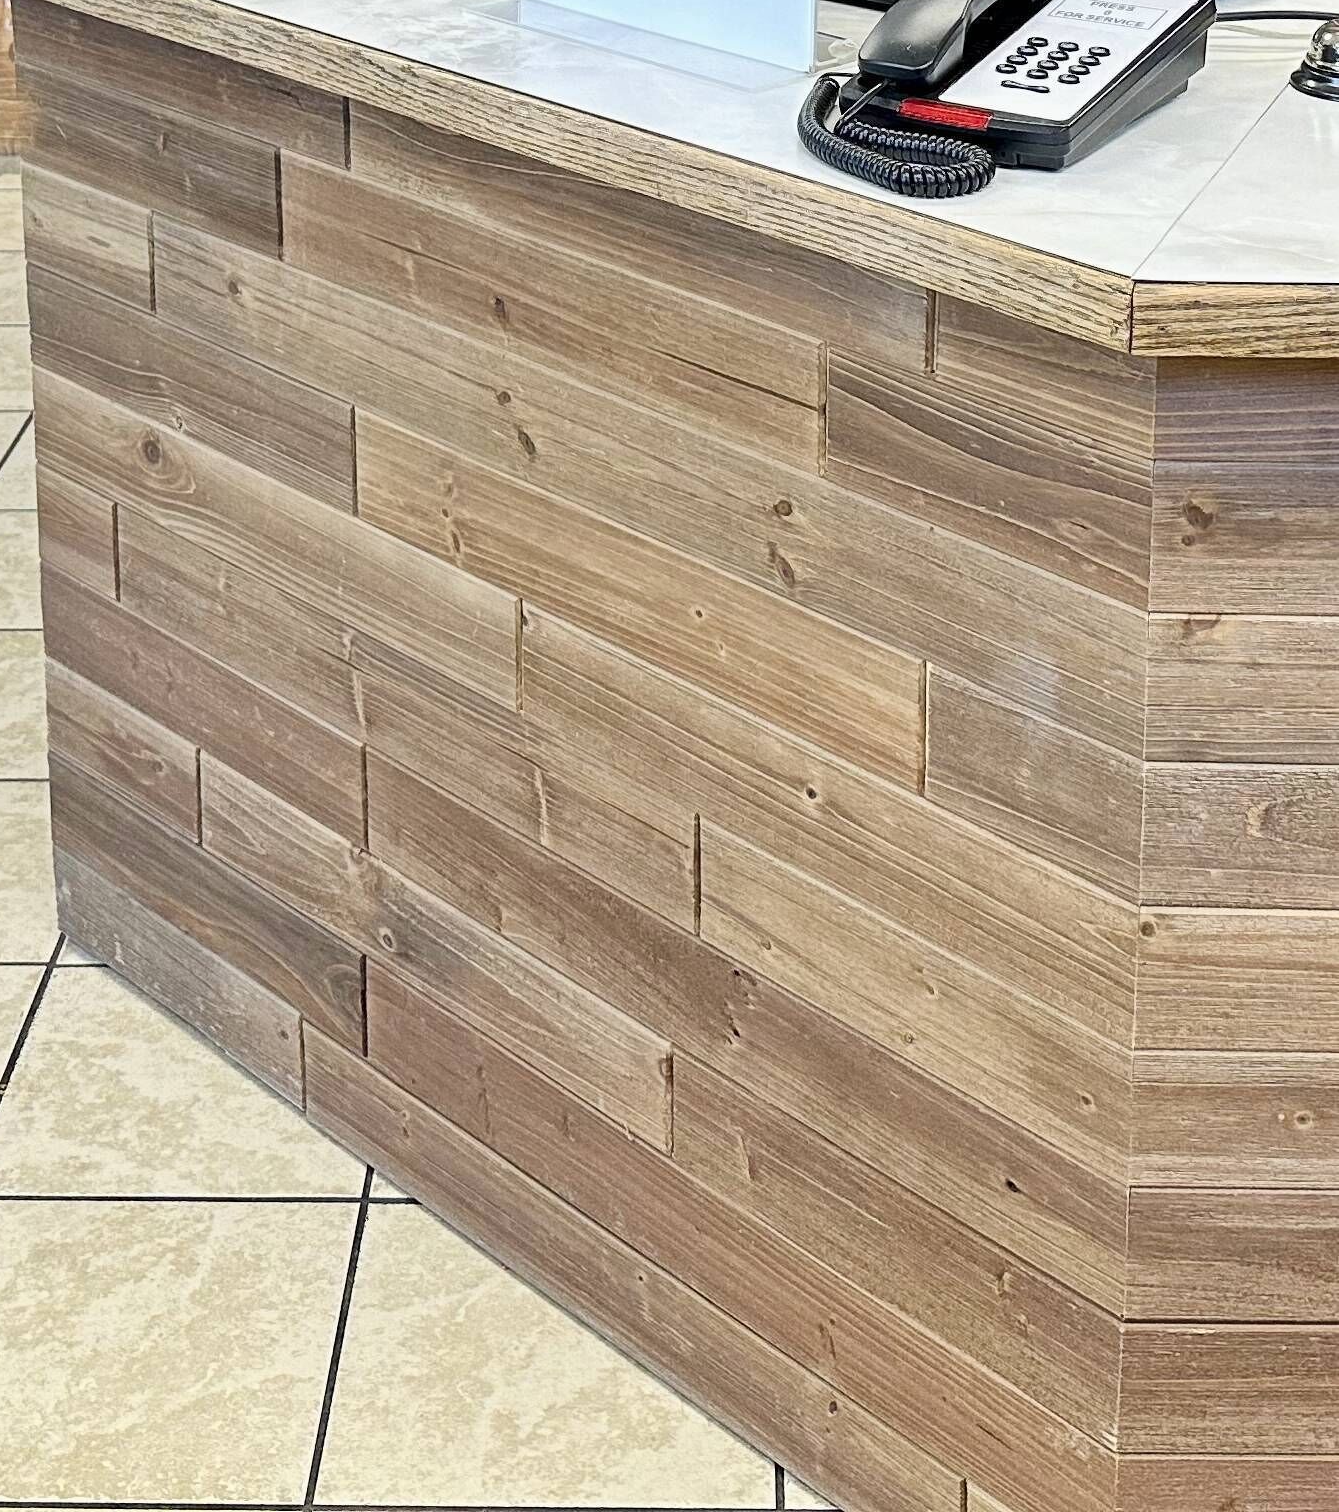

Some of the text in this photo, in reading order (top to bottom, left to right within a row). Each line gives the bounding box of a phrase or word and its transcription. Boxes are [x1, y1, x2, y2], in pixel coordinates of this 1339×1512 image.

[1090, 1, 1135, 11] PRESS
[1055, 11, 1146, 27] FOR SERVICE
